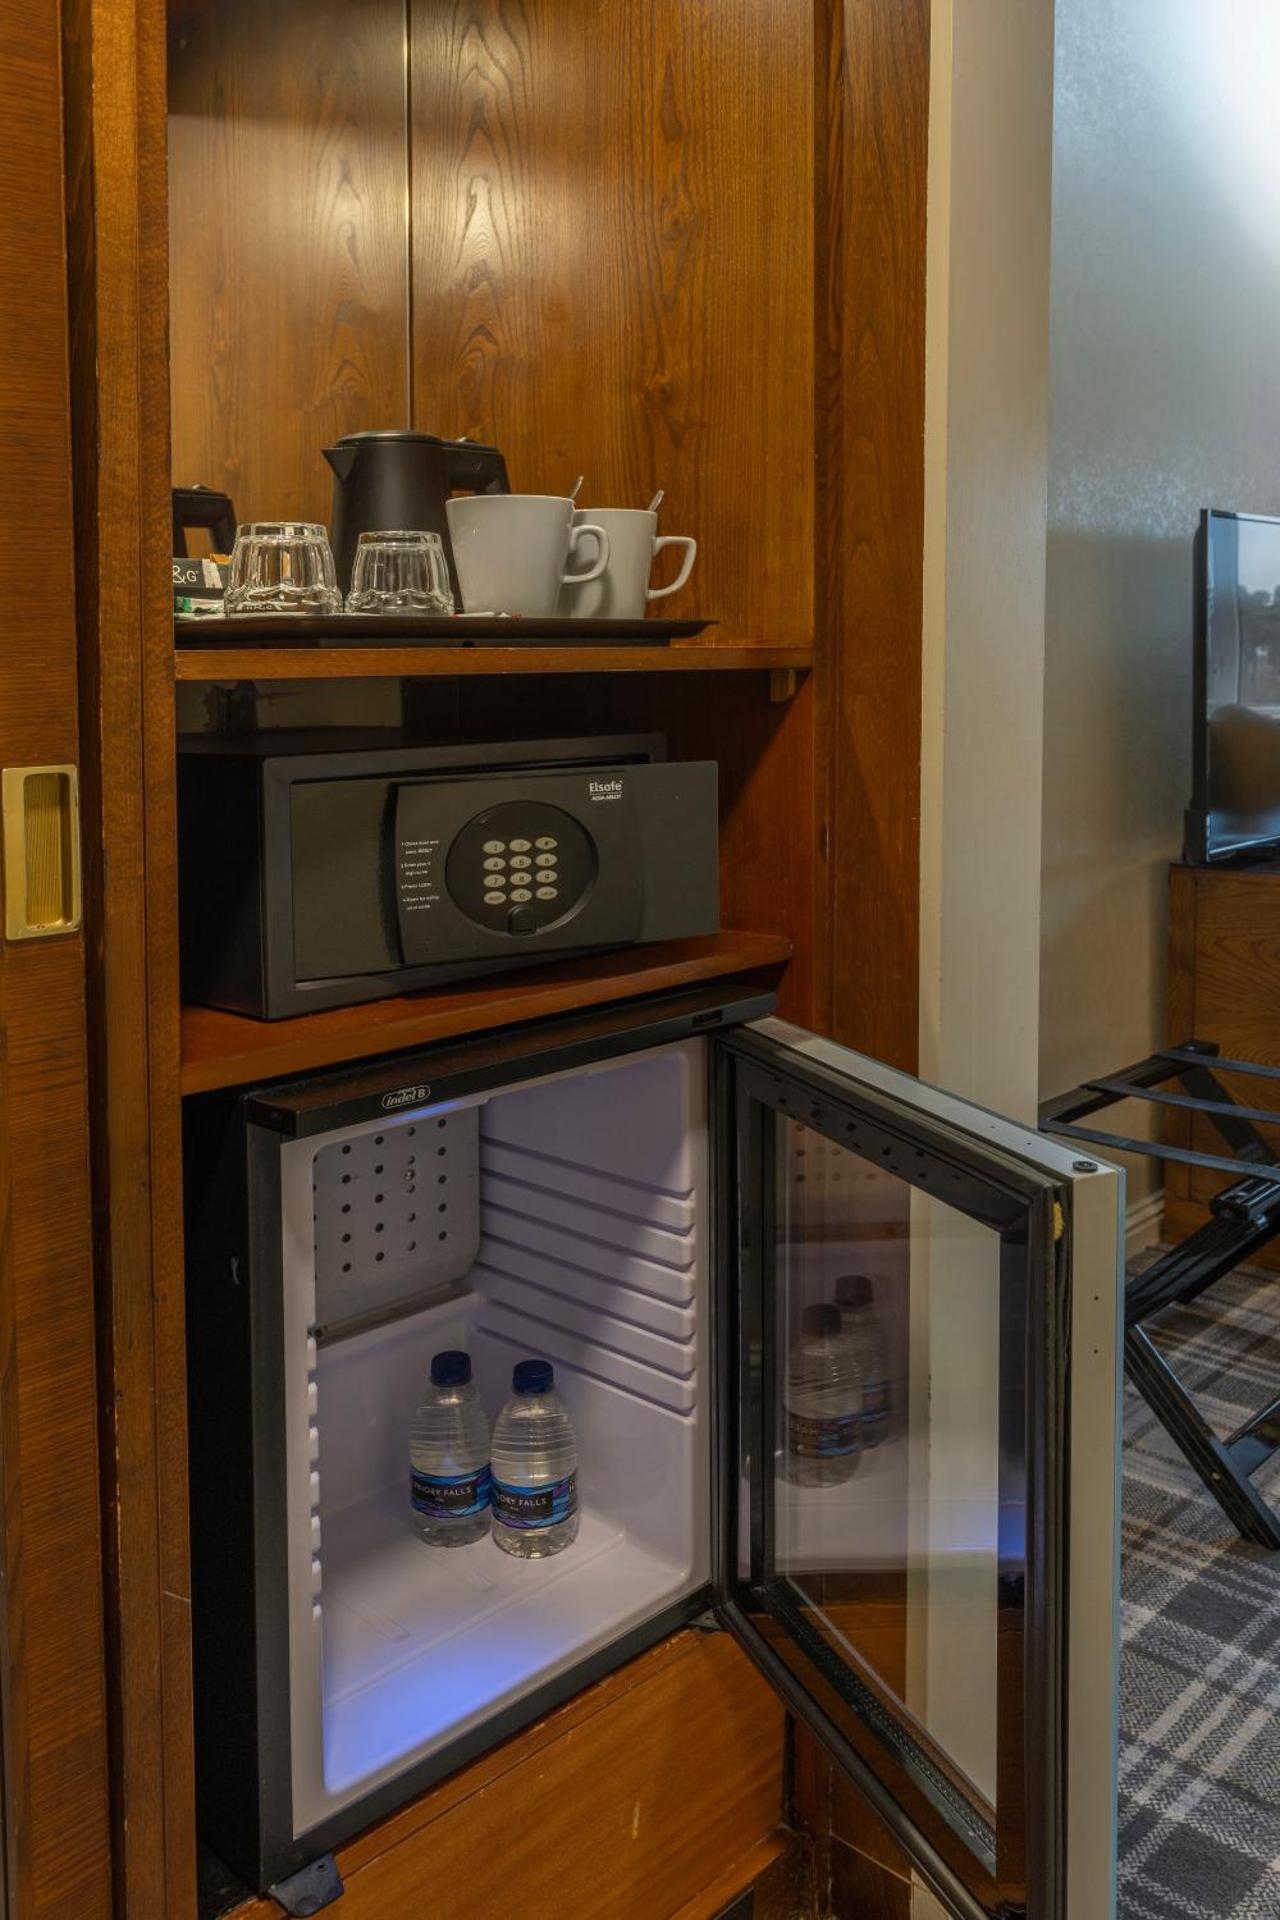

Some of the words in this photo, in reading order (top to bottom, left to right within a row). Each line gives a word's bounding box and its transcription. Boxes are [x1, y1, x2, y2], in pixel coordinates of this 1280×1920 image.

[589, 780, 622, 792] Elsafe
[418, 1088, 425, 1098] B
[443, 1485, 472, 1497] FALLS
[519, 1497, 547, 1506] FALLS
